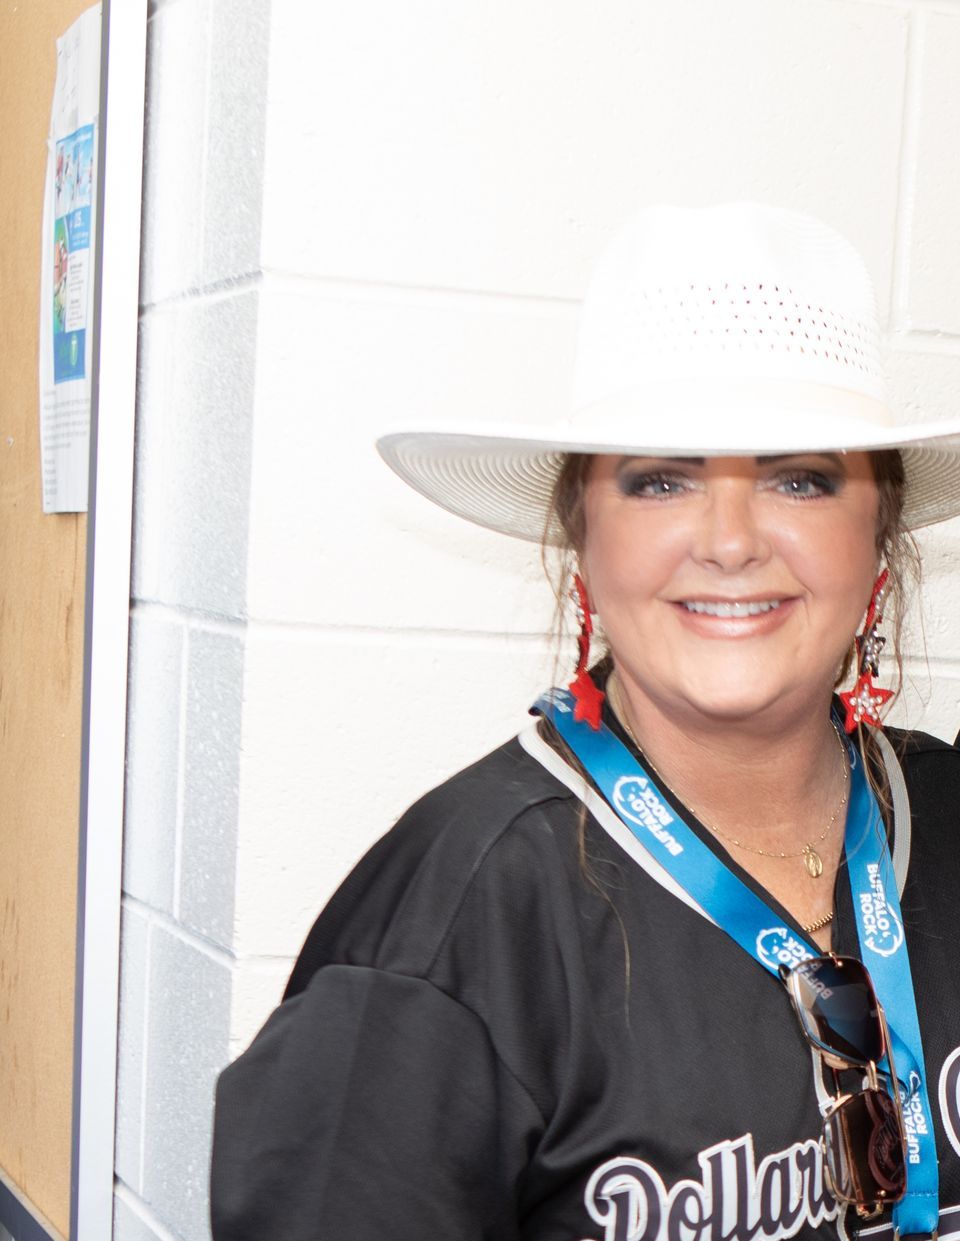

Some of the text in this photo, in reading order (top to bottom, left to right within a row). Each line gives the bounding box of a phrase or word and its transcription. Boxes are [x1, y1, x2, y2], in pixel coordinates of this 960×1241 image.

[631, 798, 684, 856] BUFFALO
[639, 787, 674, 827] ROCK
[860, 892, 879, 935] ROCK
[867, 863, 890, 932] BUFFALO
[909, 1091, 929, 1135] ROCK
